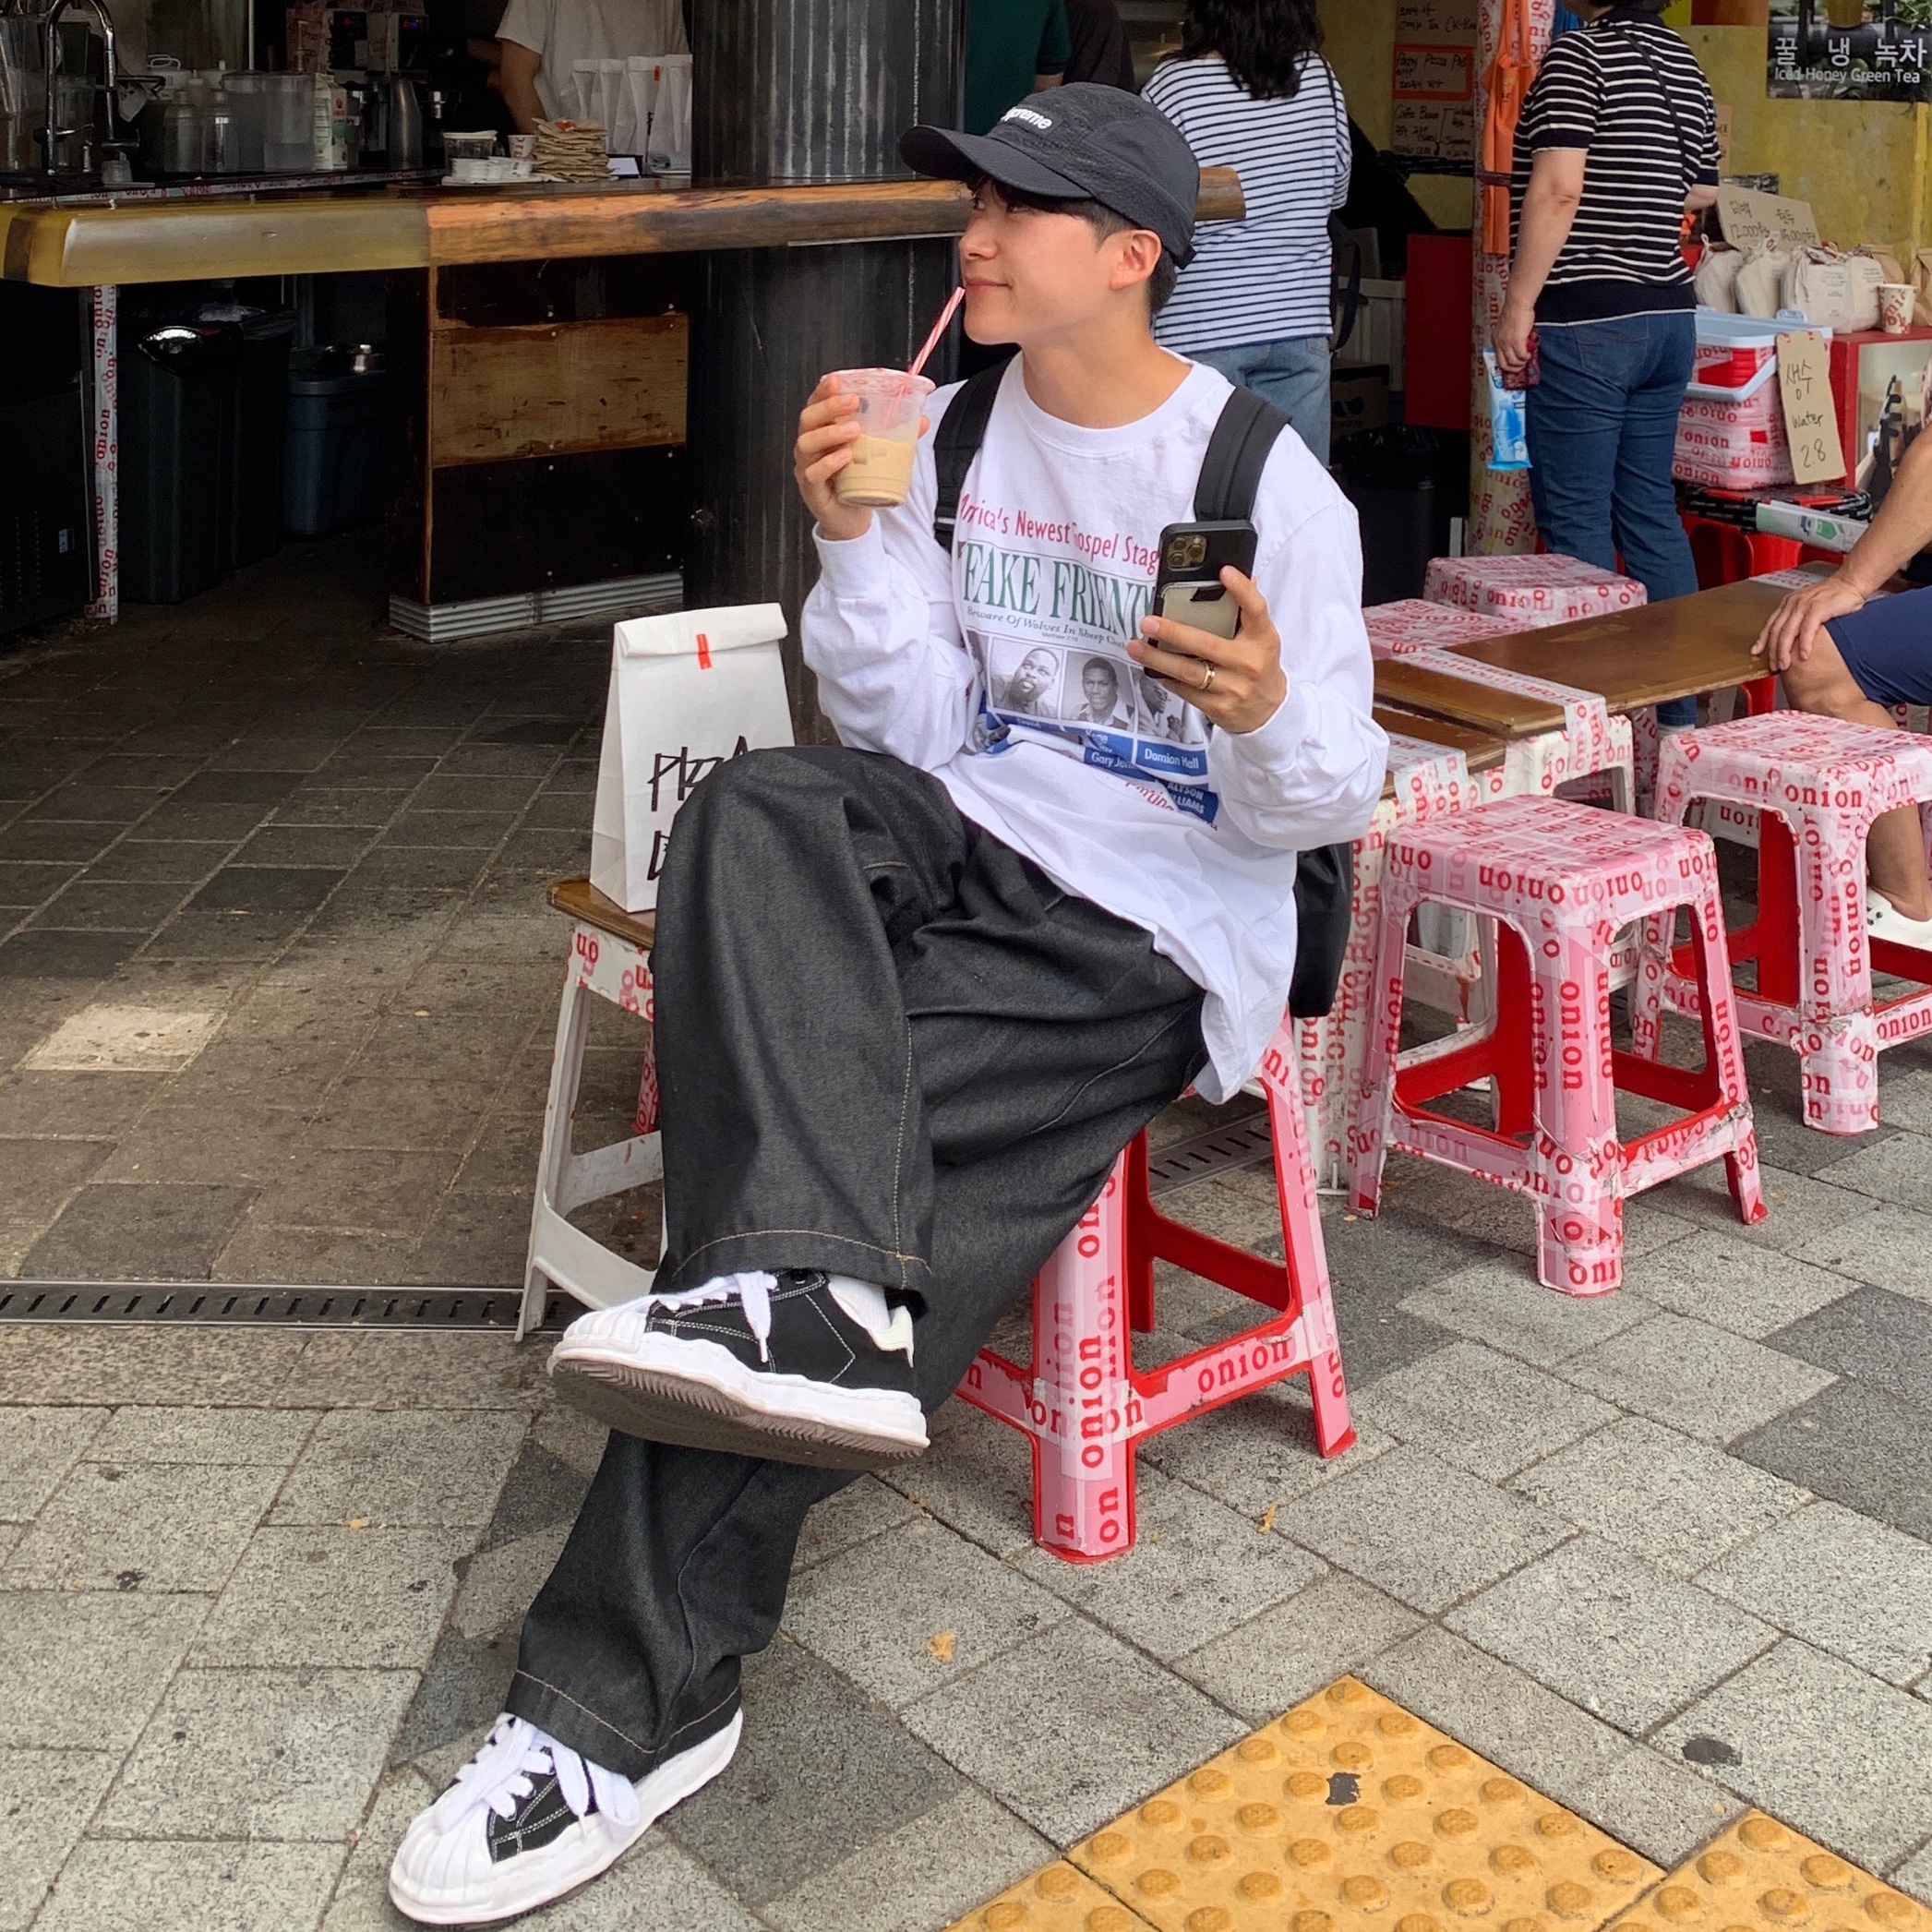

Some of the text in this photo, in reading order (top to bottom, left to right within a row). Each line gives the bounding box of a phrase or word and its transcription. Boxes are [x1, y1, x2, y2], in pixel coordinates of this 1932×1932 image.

[1775, 37, 1927, 68] 꿀 냉 녹차
[1775, 67, 1921, 84] Iced Honey Green Tea
[1785, 359, 1812, 400] 생수
[1684, 433, 1730, 449] onion
[1801, 438, 1826, 469] 2.8
[1674, 463, 1720, 484] onion
[1015, 510, 1070, 543] Newest
[1122, 535, 1159, 576] Stag
[963, 542, 1041, 616] FAKE
[967, 606, 1004, 623] Beware
[1006, 614, 1024, 630] Of
[1024, 618, 1062, 634] Wolves
[1062, 624, 1076, 635] In
[1078, 628, 1105, 644] Sheep
[1091, 751, 1114, 768] Gary
[1145, 748, 1199, 770] Damion Hall
[1784, 785, 1863, 809] onion
[1479, 864, 1566, 905] onion
[1845, 881, 1863, 977] onion
[1560, 981, 1584, 1091] onion
[1597, 971, 1614, 1079] onion
[1877, 1007, 1932, 1040] onion
[1715, 1000, 1739, 1101] onion
[1198, 1340, 1290, 1393] onion
[1079, 1335, 1104, 1469] onion
